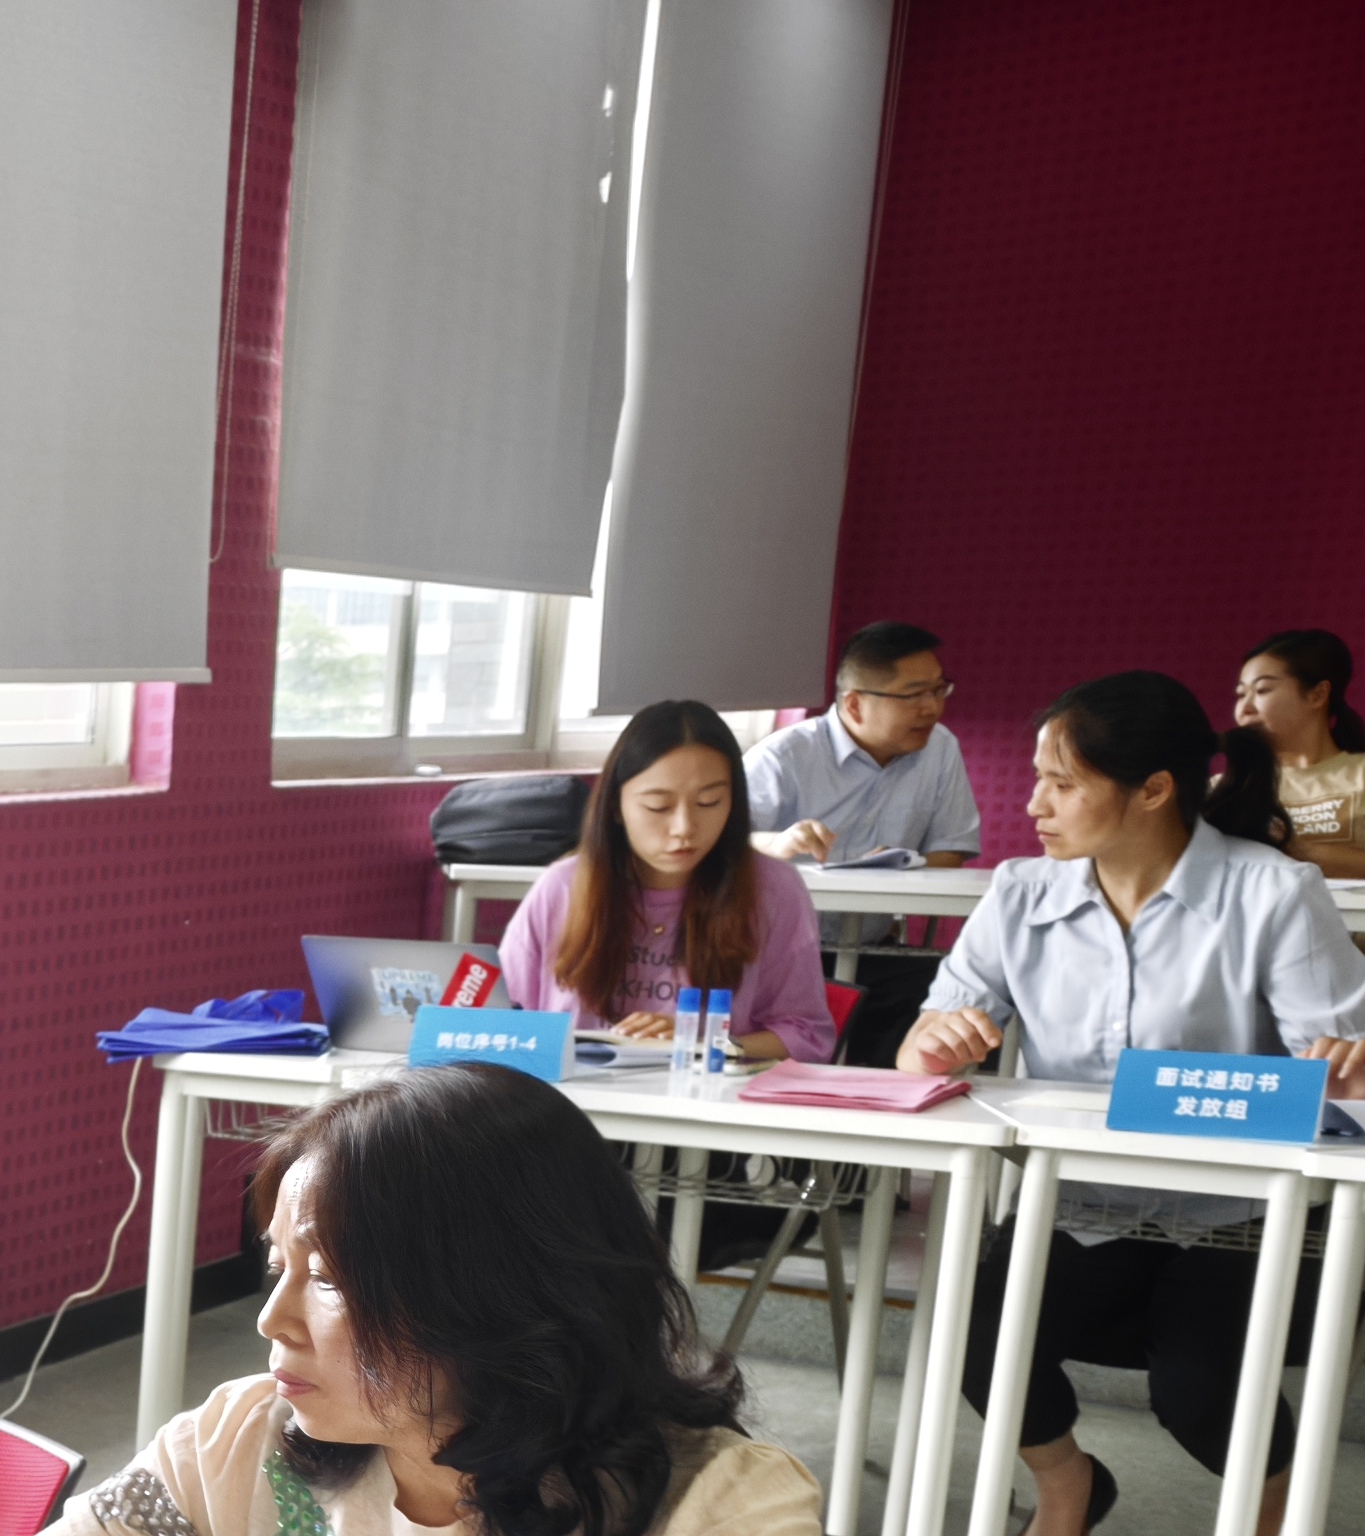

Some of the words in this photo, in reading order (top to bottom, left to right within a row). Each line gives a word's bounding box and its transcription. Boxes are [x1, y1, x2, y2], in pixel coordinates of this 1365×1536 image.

[436, 1032, 537, 1051] 岗位序号1-4
[1155, 1067, 1281, 1093] 面试通知书
[1174, 1096, 1249, 1120] 发放组
